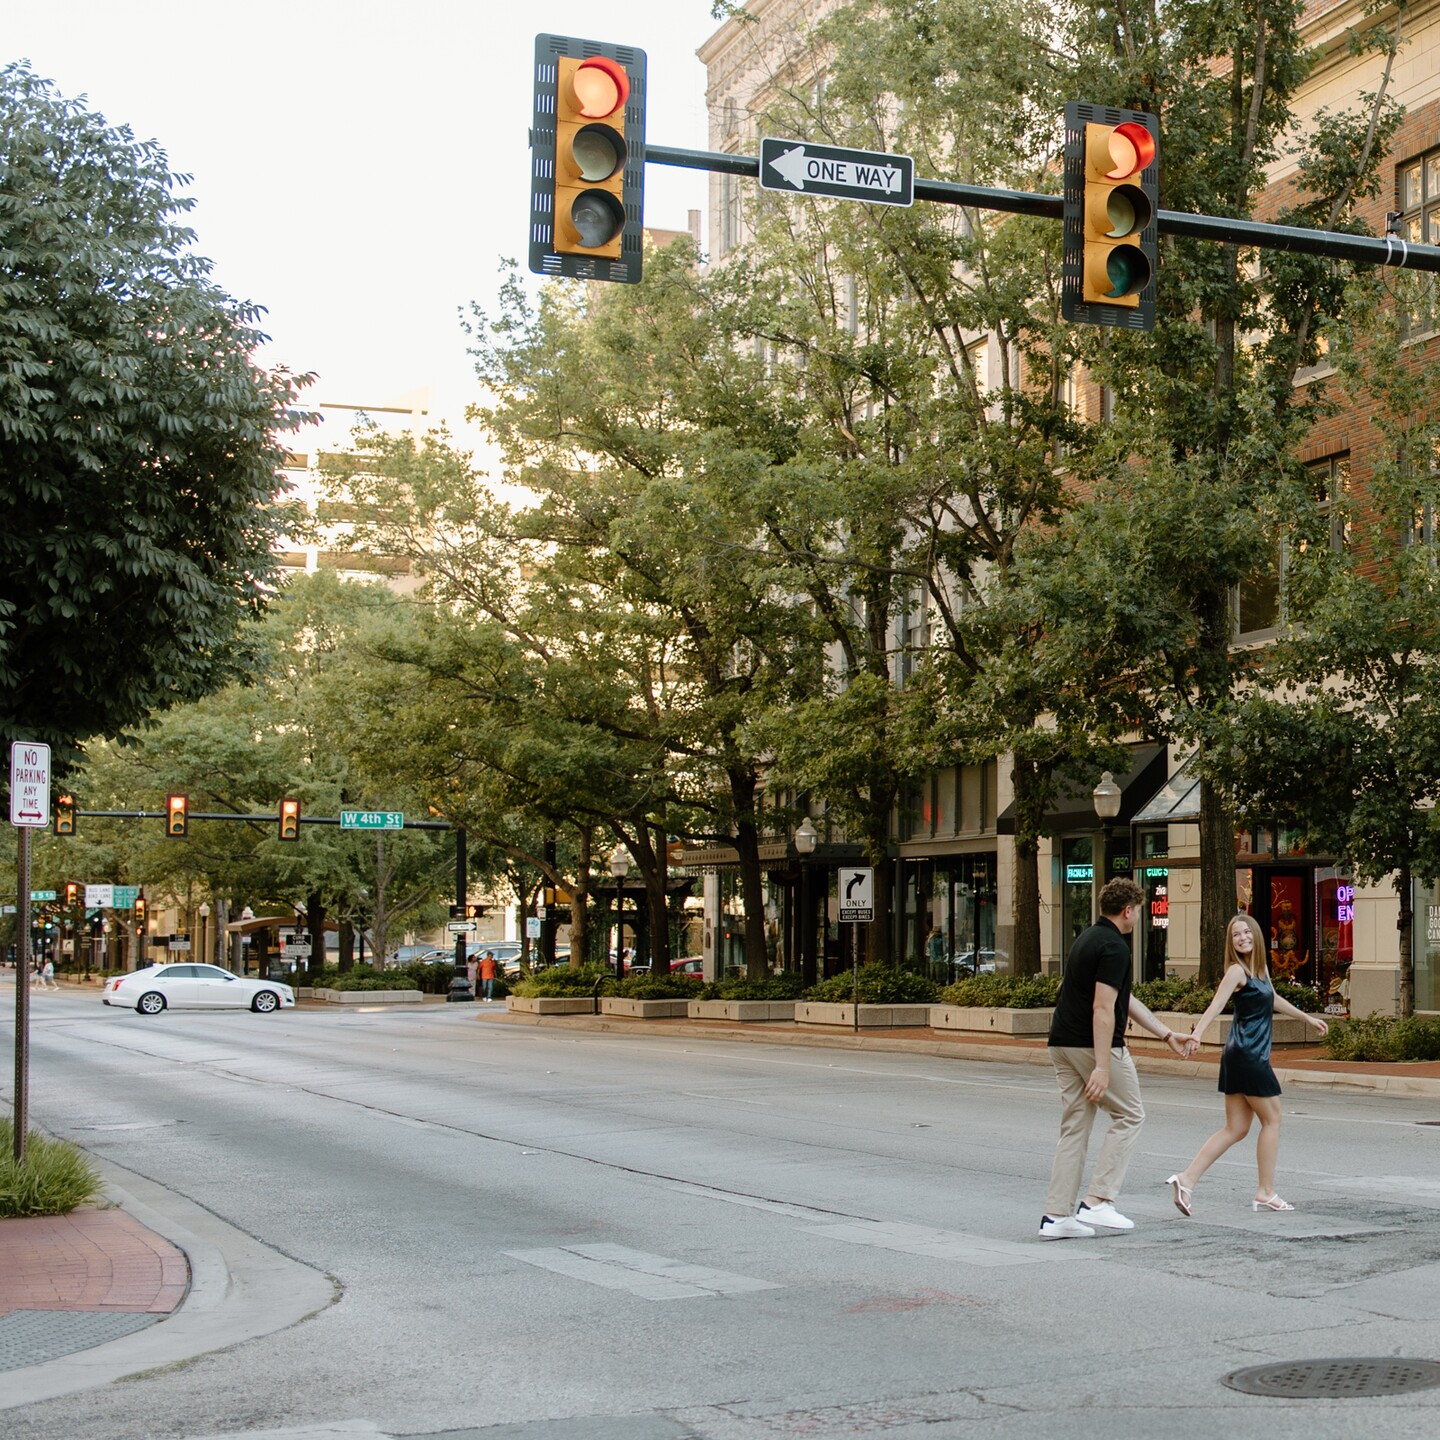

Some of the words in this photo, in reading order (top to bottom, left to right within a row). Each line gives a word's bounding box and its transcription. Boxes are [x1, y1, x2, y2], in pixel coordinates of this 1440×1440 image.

[807, 160, 847, 182] ONE
[855, 166, 896, 188] WAY
[24, 751, 37, 766] NO
[16, 768, 46, 784] PARKING
[24, 785, 37, 796] ANY
[22, 798, 38, 809] TIME
[344, 813, 357, 824] W
[360, 813, 381, 824] 4th
[386, 814, 400, 824] St
[1151, 896, 1168, 915] nails
[1152, 916, 1169, 929] lounge
